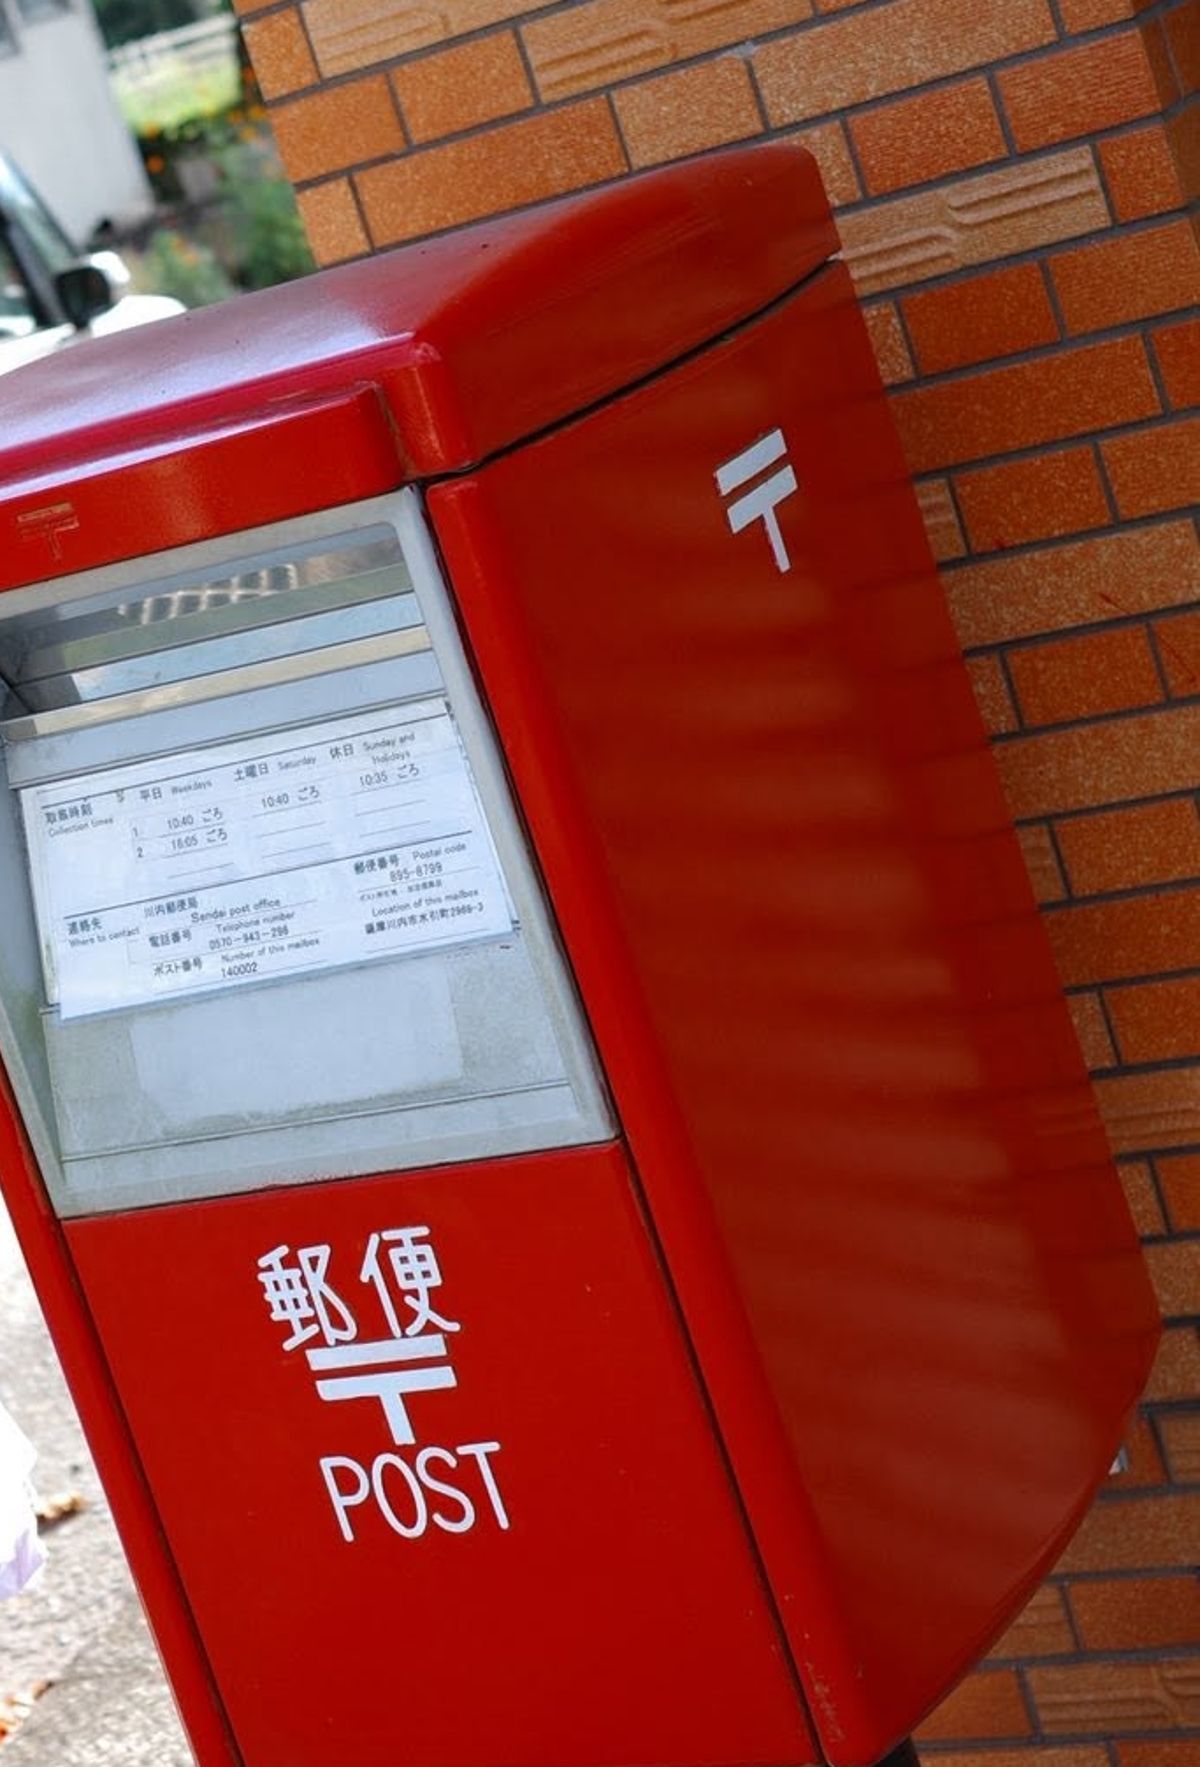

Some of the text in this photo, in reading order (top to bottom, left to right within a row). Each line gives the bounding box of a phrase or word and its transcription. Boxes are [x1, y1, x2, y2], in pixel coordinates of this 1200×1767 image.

[329, 743, 354, 759] 休日
[362, 737, 396, 752] Sunday
[277, 755, 316, 771] Saturday
[371, 751, 411, 765] Holidays
[233, 762, 269, 782] 土曜日
[359, 763, 420, 786] 10:35 ごろ
[261, 785, 320, 808] 10:40 ごろ
[167, 807, 223, 830] 10:40 ごろ
[206, 828, 227, 843] ごろ
[412, 842, 467, 861] Postal code
[190, 897, 281, 923] Sendai post office
[372, 902, 411, 917] Location
[216, 910, 295, 934] Telephone number
[149, 929, 192, 948] 電話番号
[221, 949, 255, 962] Number
[221, 962, 258, 978] 140002
[257, 1225, 461, 1351] 郵便
[319, 1440, 509, 1542] POST
